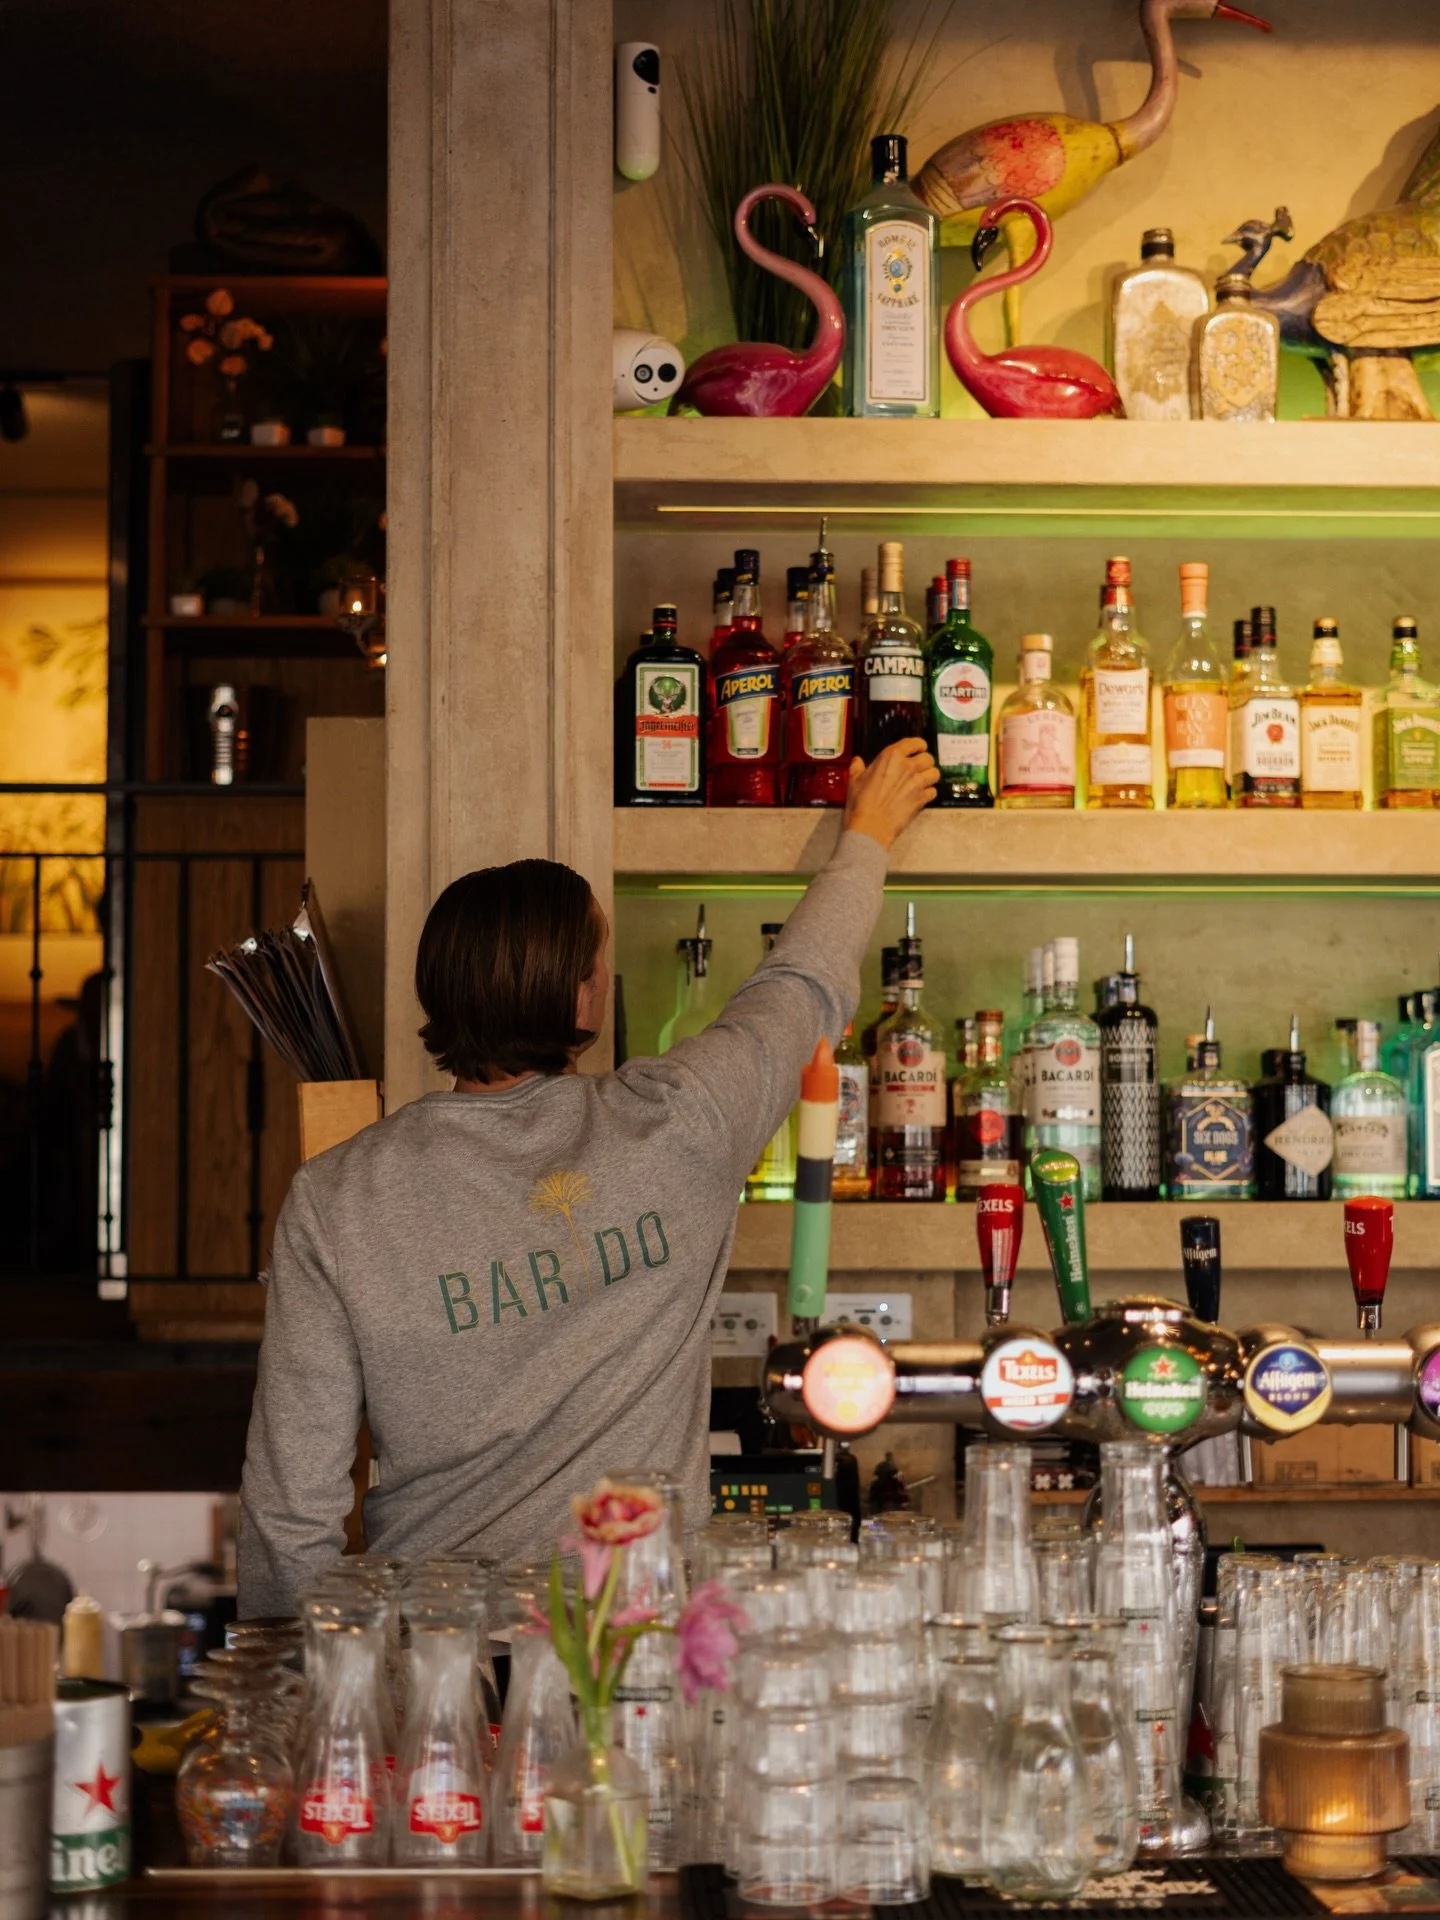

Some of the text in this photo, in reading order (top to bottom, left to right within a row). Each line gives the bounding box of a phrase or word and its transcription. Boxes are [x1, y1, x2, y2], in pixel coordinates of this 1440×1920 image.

[864, 656, 925, 677] CAMPAR
[720, 672, 774, 700] APEROL
[798, 673, 851, 700] APEROL
[940, 686, 987, 699] MARTINI
[977, 1197, 1014, 1214] EXELS
[1061, 1214, 1083, 1283] Heineken
[437, 1210, 670, 1335] BAR DO
[1124, 1381, 1202, 1399] Heineken
[1267, 1391, 1310, 1403] BLOND
